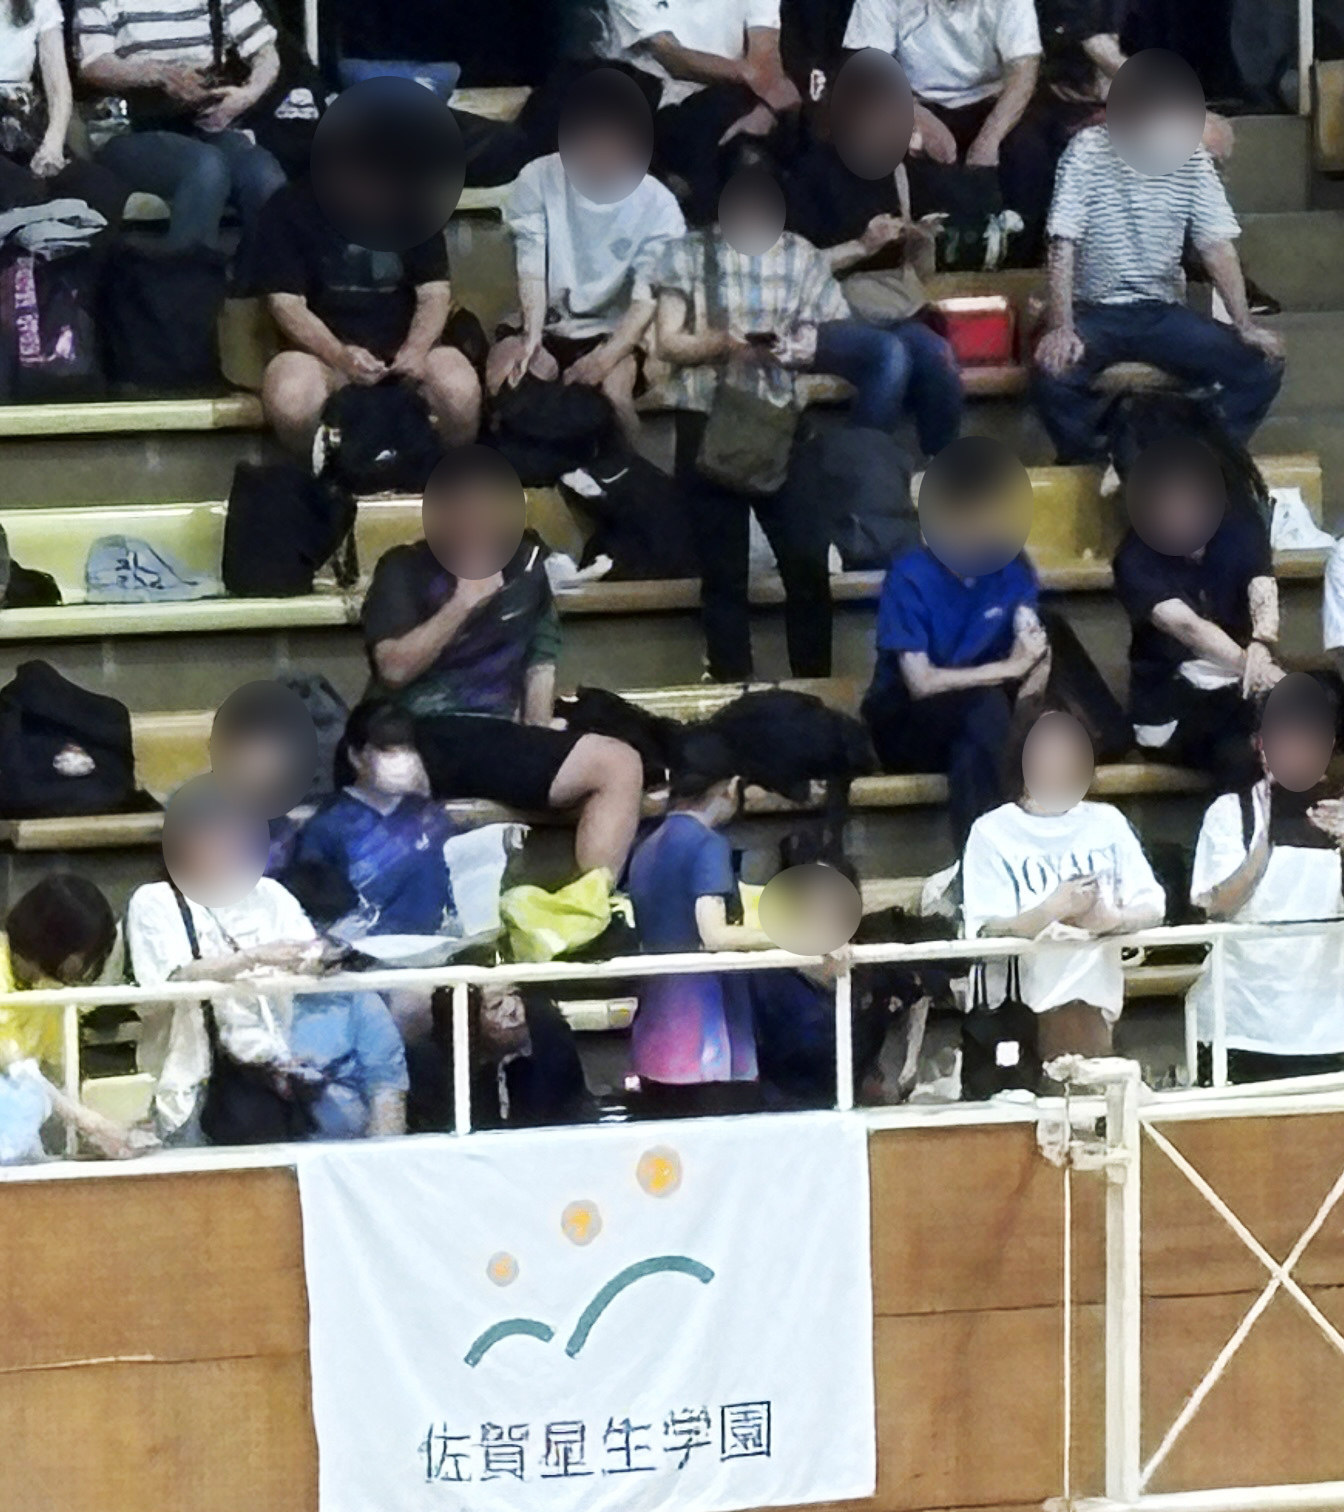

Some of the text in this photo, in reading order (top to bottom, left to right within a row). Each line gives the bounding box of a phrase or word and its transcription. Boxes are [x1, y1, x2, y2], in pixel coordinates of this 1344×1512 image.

[420, 1400, 772, 1483] 佐賀星生学園
